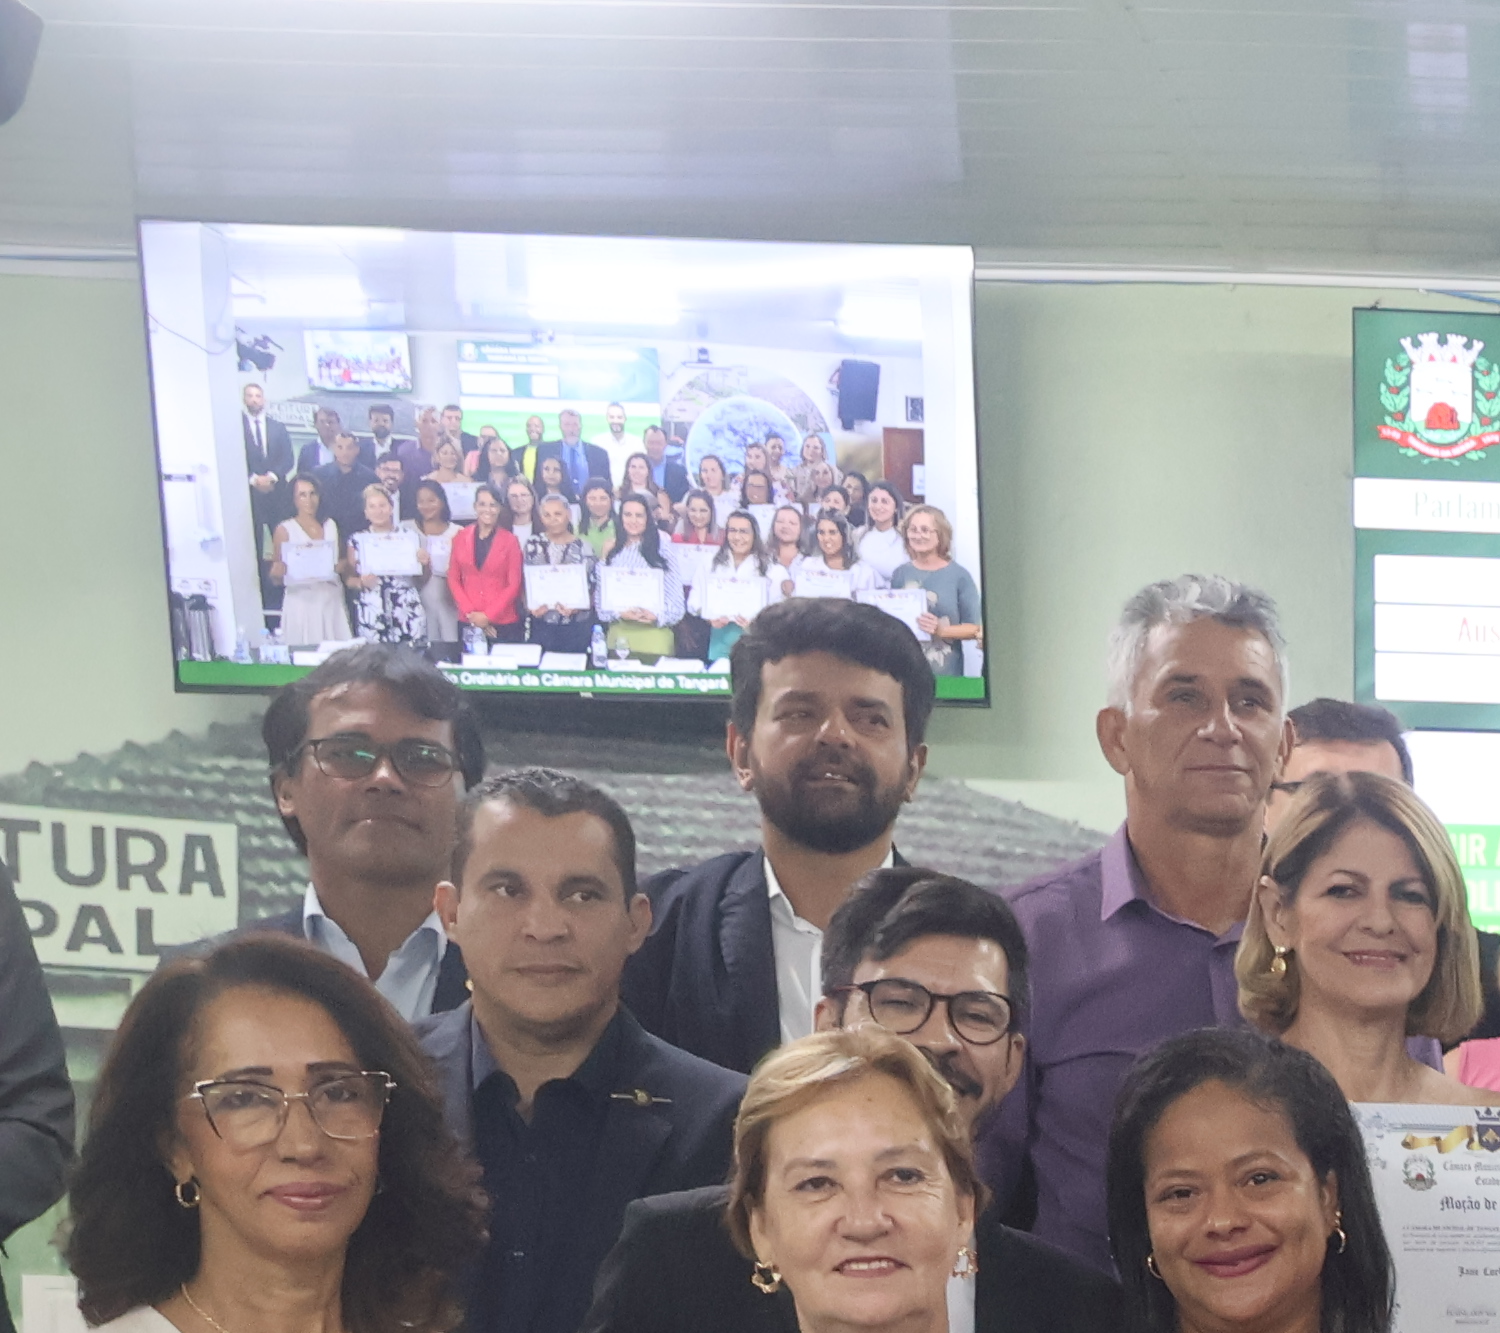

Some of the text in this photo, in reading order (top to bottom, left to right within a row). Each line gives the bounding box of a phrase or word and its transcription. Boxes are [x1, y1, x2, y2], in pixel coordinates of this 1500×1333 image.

[460, 671, 728, 693] Ordinária da Câmara Municipal de Tangará
[1440, 1197, 1481, 1213] Moção
[1484, 1197, 1497, 1211] de
